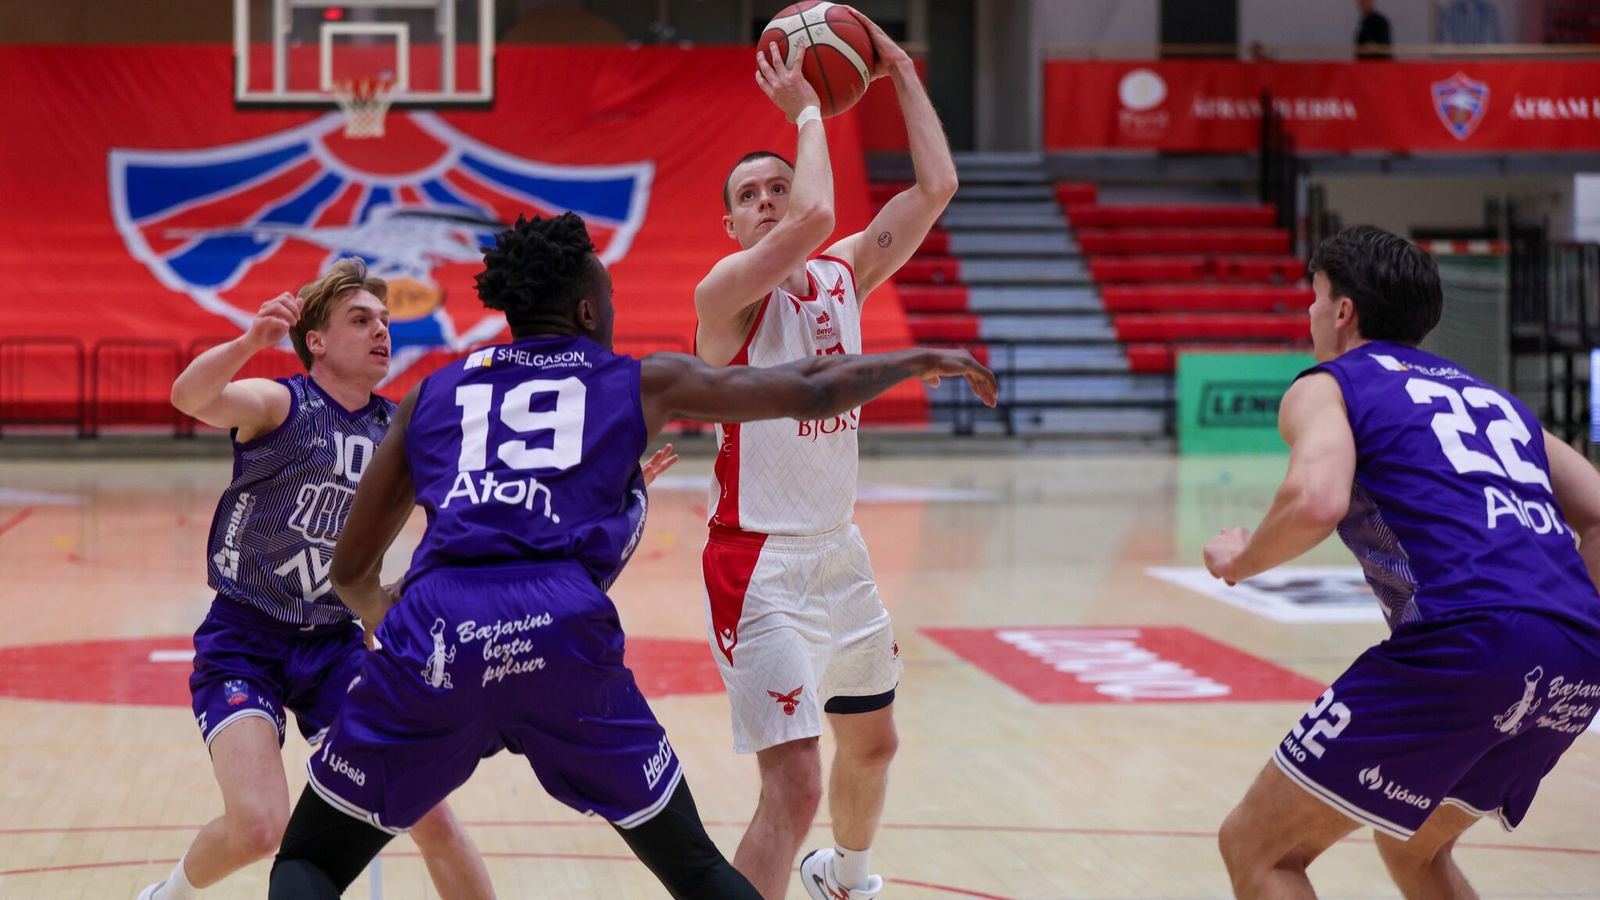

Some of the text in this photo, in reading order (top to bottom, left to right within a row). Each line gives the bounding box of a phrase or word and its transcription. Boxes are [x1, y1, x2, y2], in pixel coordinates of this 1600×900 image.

[497, 349, 585, 367] S:HELGASON
[456, 376, 587, 472] 19
[1405, 377, 1553, 494] 22
[333, 431, 374, 483] 10
[440, 471, 560, 524] Aton.
[225, 492, 250, 547] PRIMA
[456, 612, 553, 643] Bæjarins
[483, 638, 534, 662] beztu
[482, 656, 546, 688] pylsur
[1292, 686, 1352, 760] 22
[1284, 735, 1307, 762] JAKO
[329, 753, 366, 787] Ljósið
[1383, 780, 1432, 811] Ljósið
